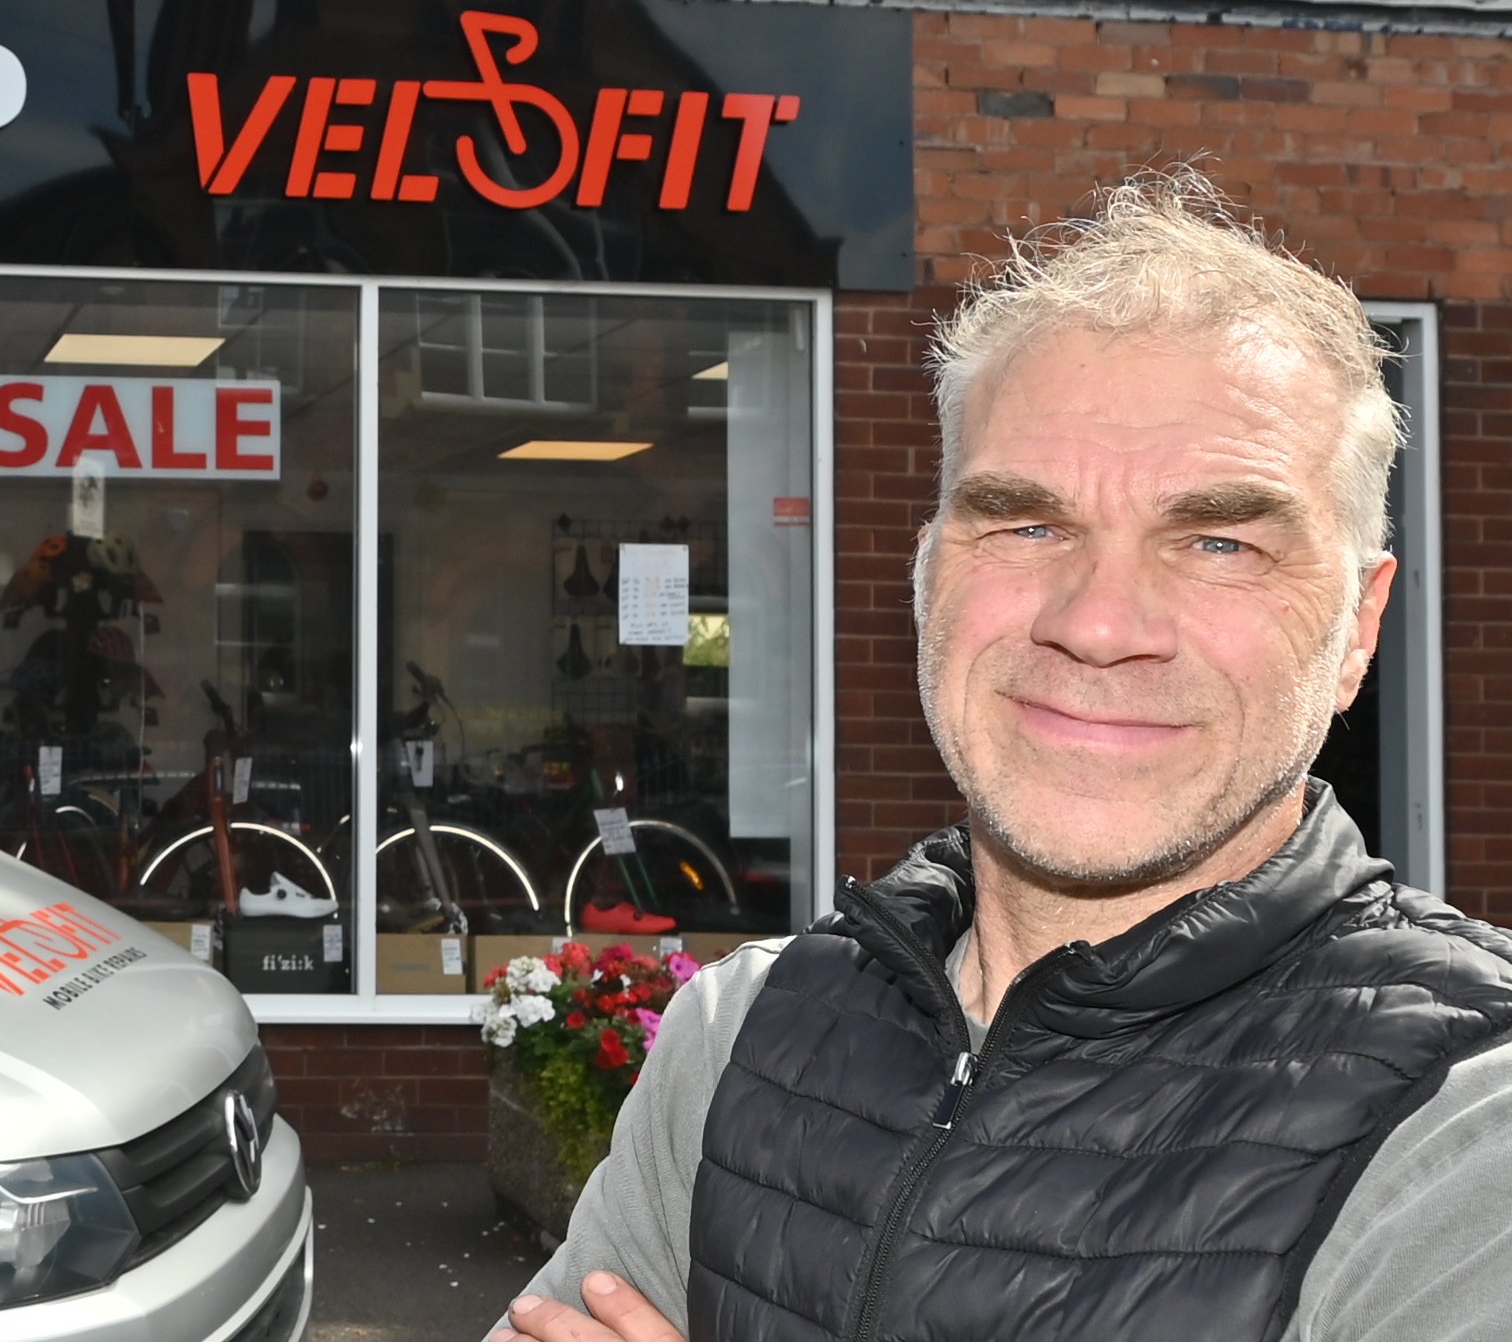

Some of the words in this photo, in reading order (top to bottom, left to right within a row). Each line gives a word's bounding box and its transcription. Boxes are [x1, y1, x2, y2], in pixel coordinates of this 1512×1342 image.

[186, 9, 801, 211] VELOFIT
[42, 976, 94, 1011] MOBILE
[81, 963, 115, 984] BIKE
